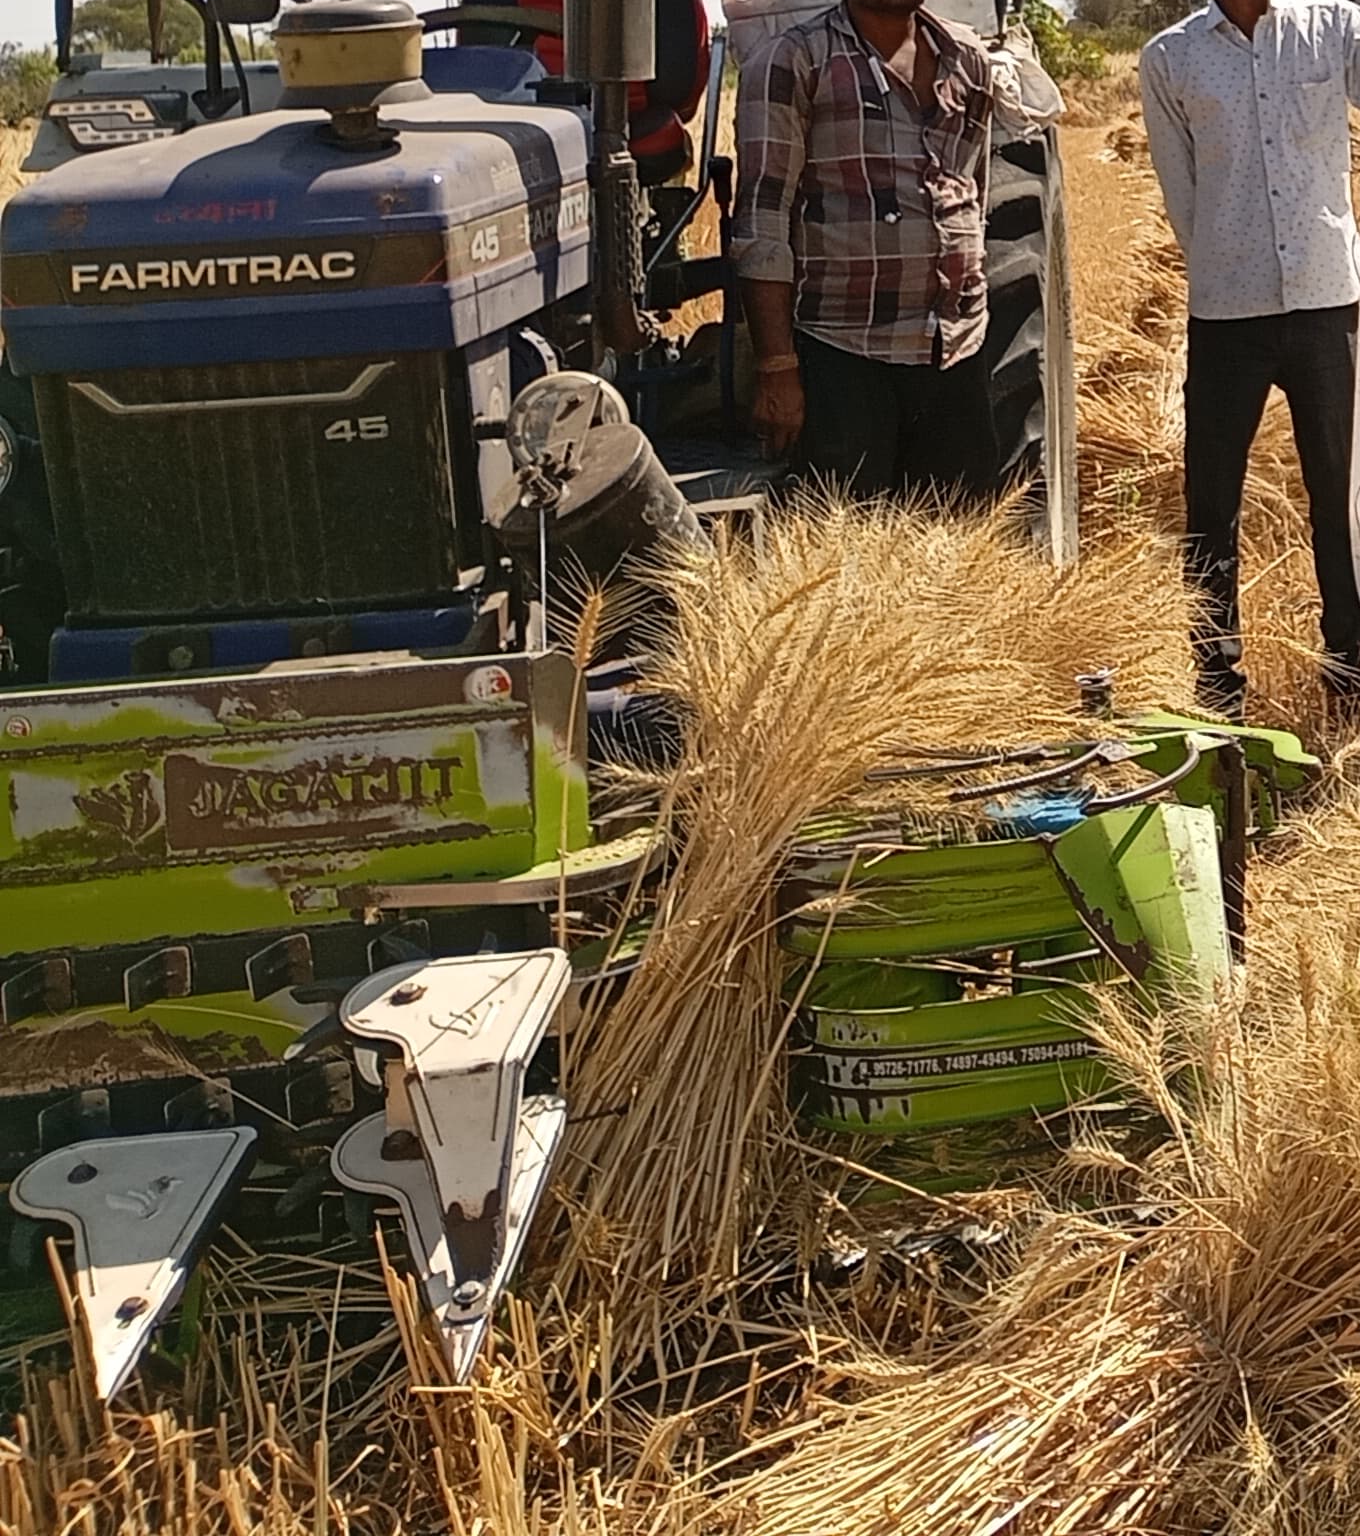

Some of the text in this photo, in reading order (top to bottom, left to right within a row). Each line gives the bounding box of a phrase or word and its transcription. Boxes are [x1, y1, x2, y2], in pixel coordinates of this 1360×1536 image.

[471, 224, 500, 263] 45
[71, 251, 355, 293] FARMTRAC
[324, 415, 389, 443] 45
[189, 755, 464, 819] JAGATJIT
